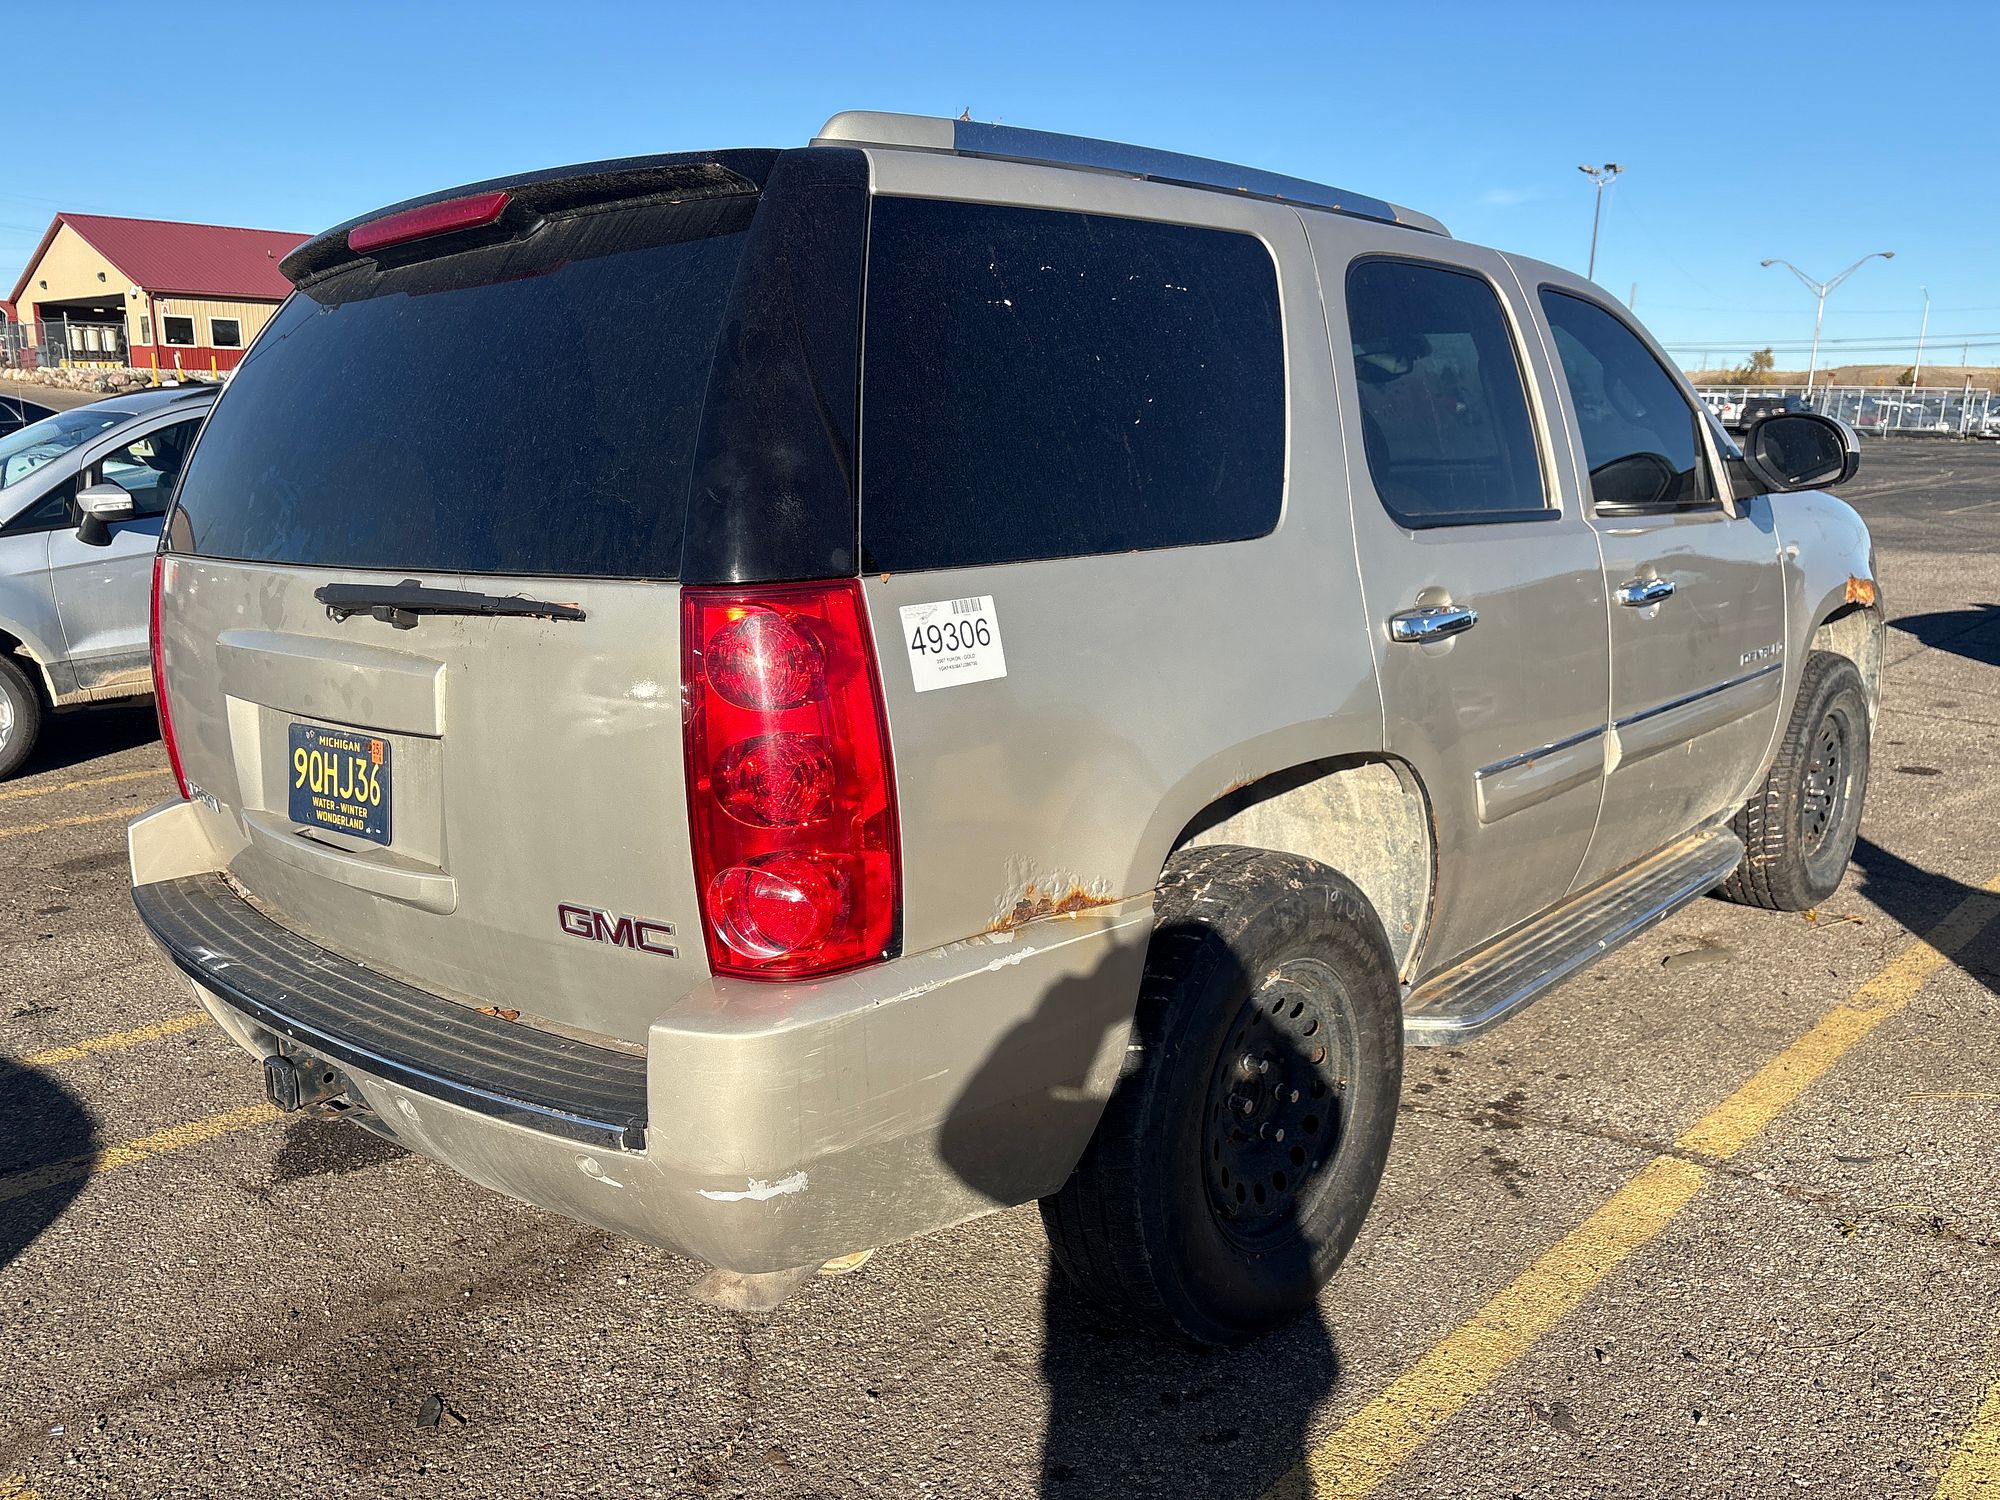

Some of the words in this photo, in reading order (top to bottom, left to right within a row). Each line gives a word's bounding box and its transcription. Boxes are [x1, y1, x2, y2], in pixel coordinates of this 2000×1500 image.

[912, 618, 990, 655] 49306
[319, 736, 360, 752] MICHIGAN
[293, 747, 381, 806] 9QHJ36
[316, 809, 364, 830] WONDERLAND
[558, 901, 679, 959] GMC
